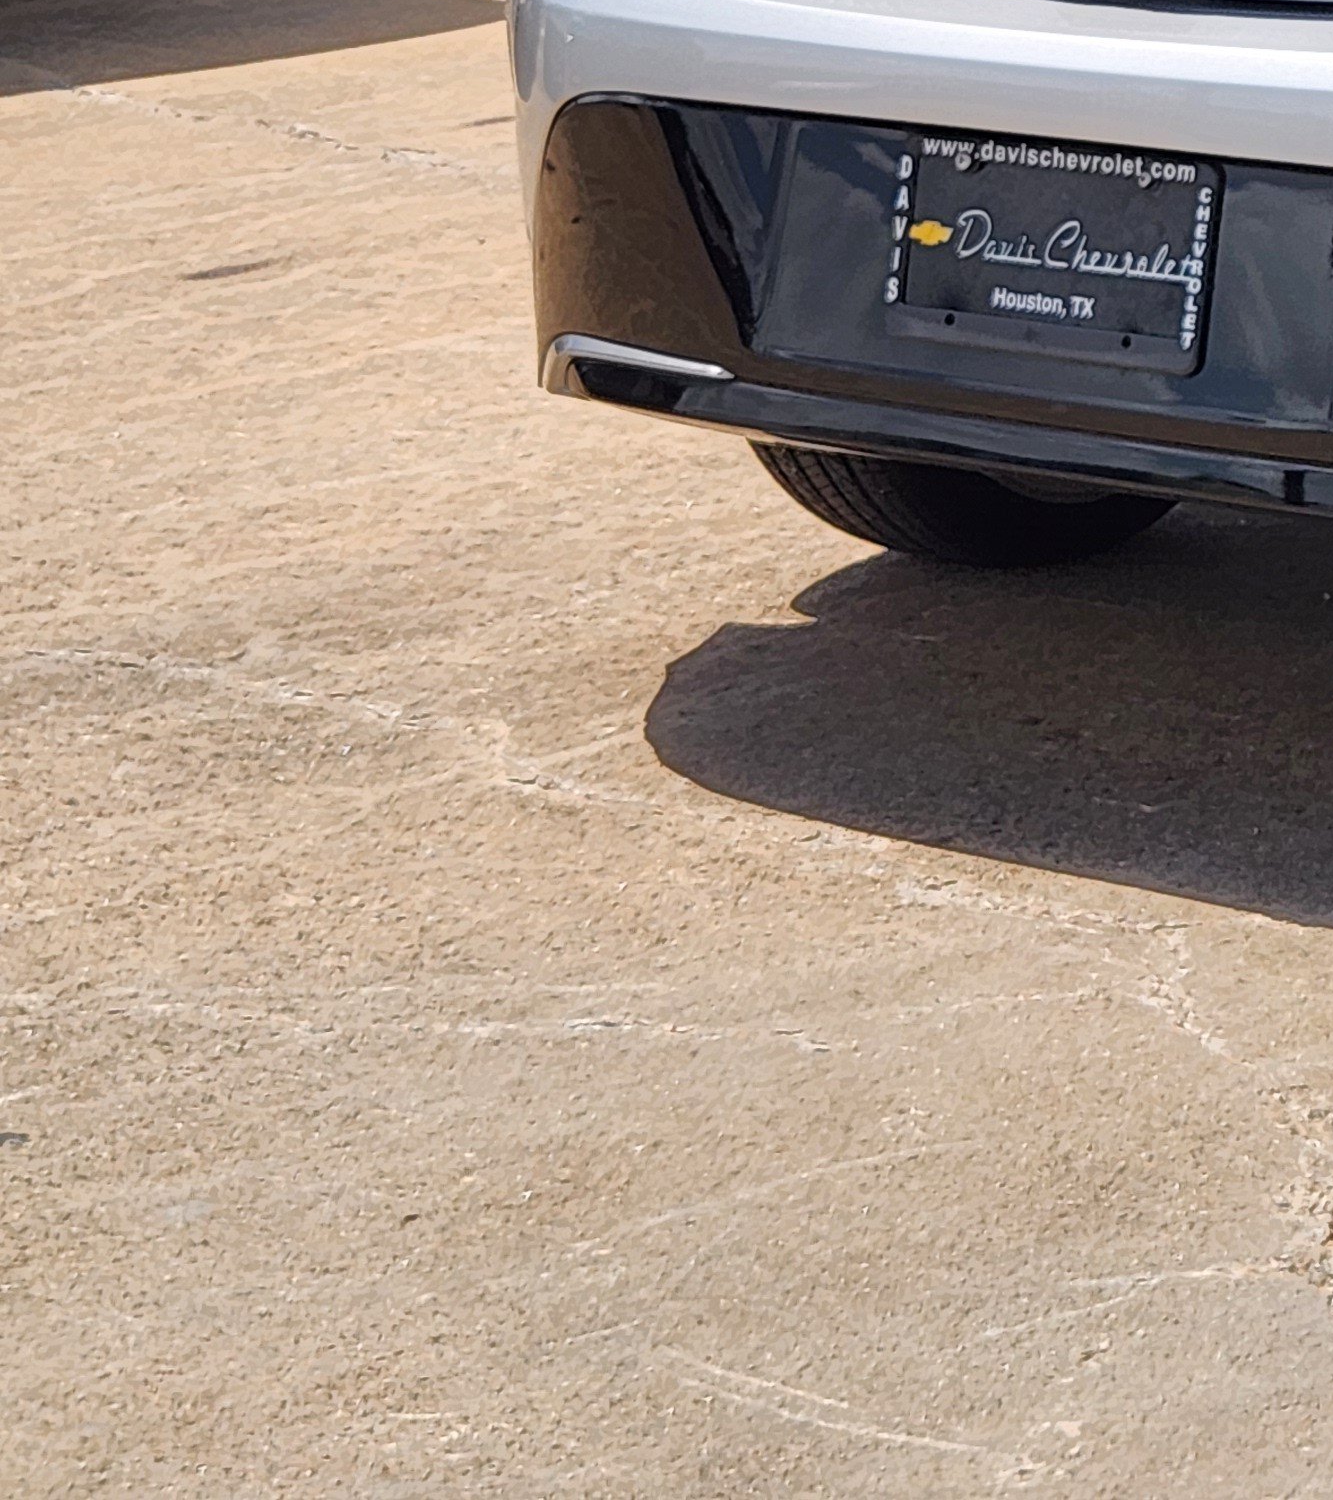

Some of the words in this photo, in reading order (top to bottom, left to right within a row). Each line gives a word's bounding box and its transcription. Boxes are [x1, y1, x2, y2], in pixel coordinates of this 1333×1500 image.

[922, 137, 1197, 184] www.davischevroletcom
[885, 153, 914, 304] DAVIS
[954, 208, 1043, 266] Davis
[1043, 220, 1198, 283] Chevrolet
[991, 286, 1069, 319] Houston,
[1069, 295, 1096, 319] TX
[1179, 186, 1214, 350] CHEVROLET
